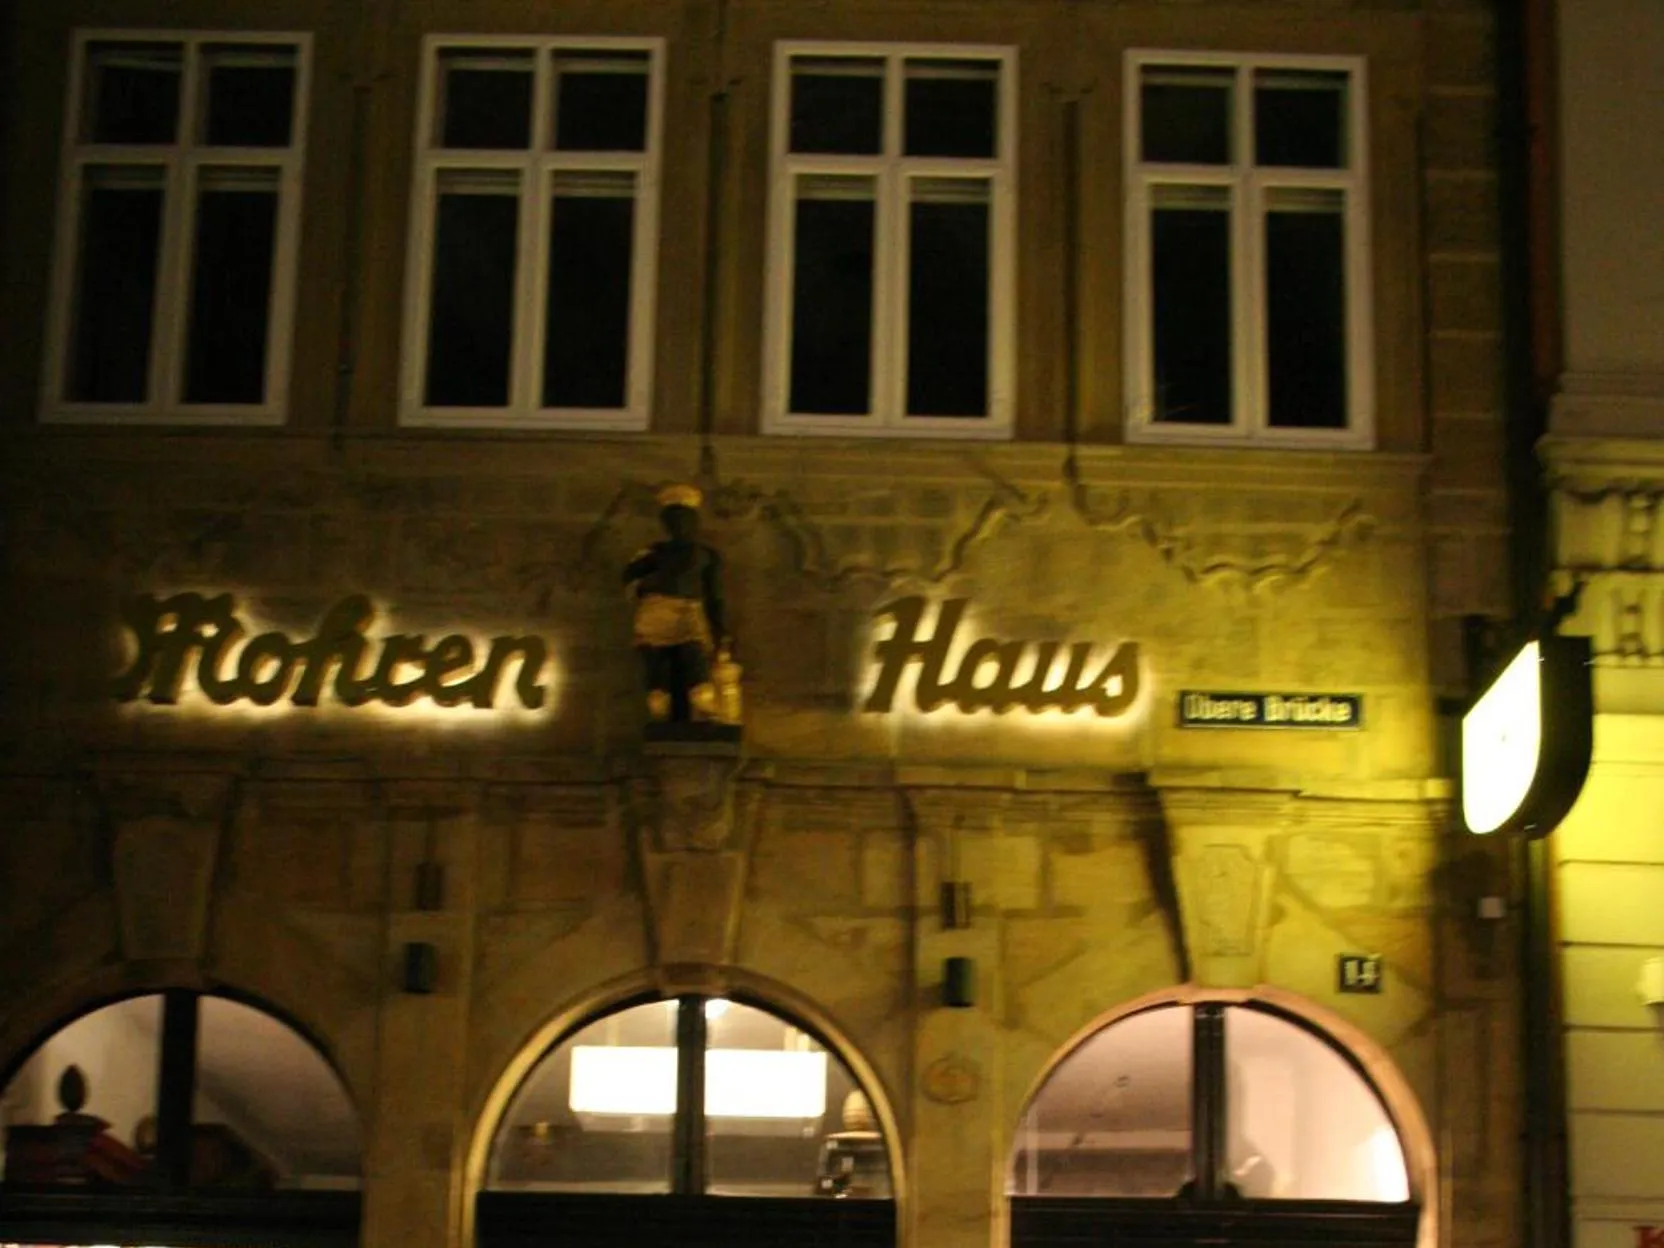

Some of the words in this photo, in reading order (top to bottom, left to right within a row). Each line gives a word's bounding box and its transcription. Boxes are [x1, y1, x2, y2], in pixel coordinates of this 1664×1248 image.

[118, 592, 548, 709] Mohren
[863, 596, 1140, 717] Haus
[1344, 960, 1379, 986] 14
